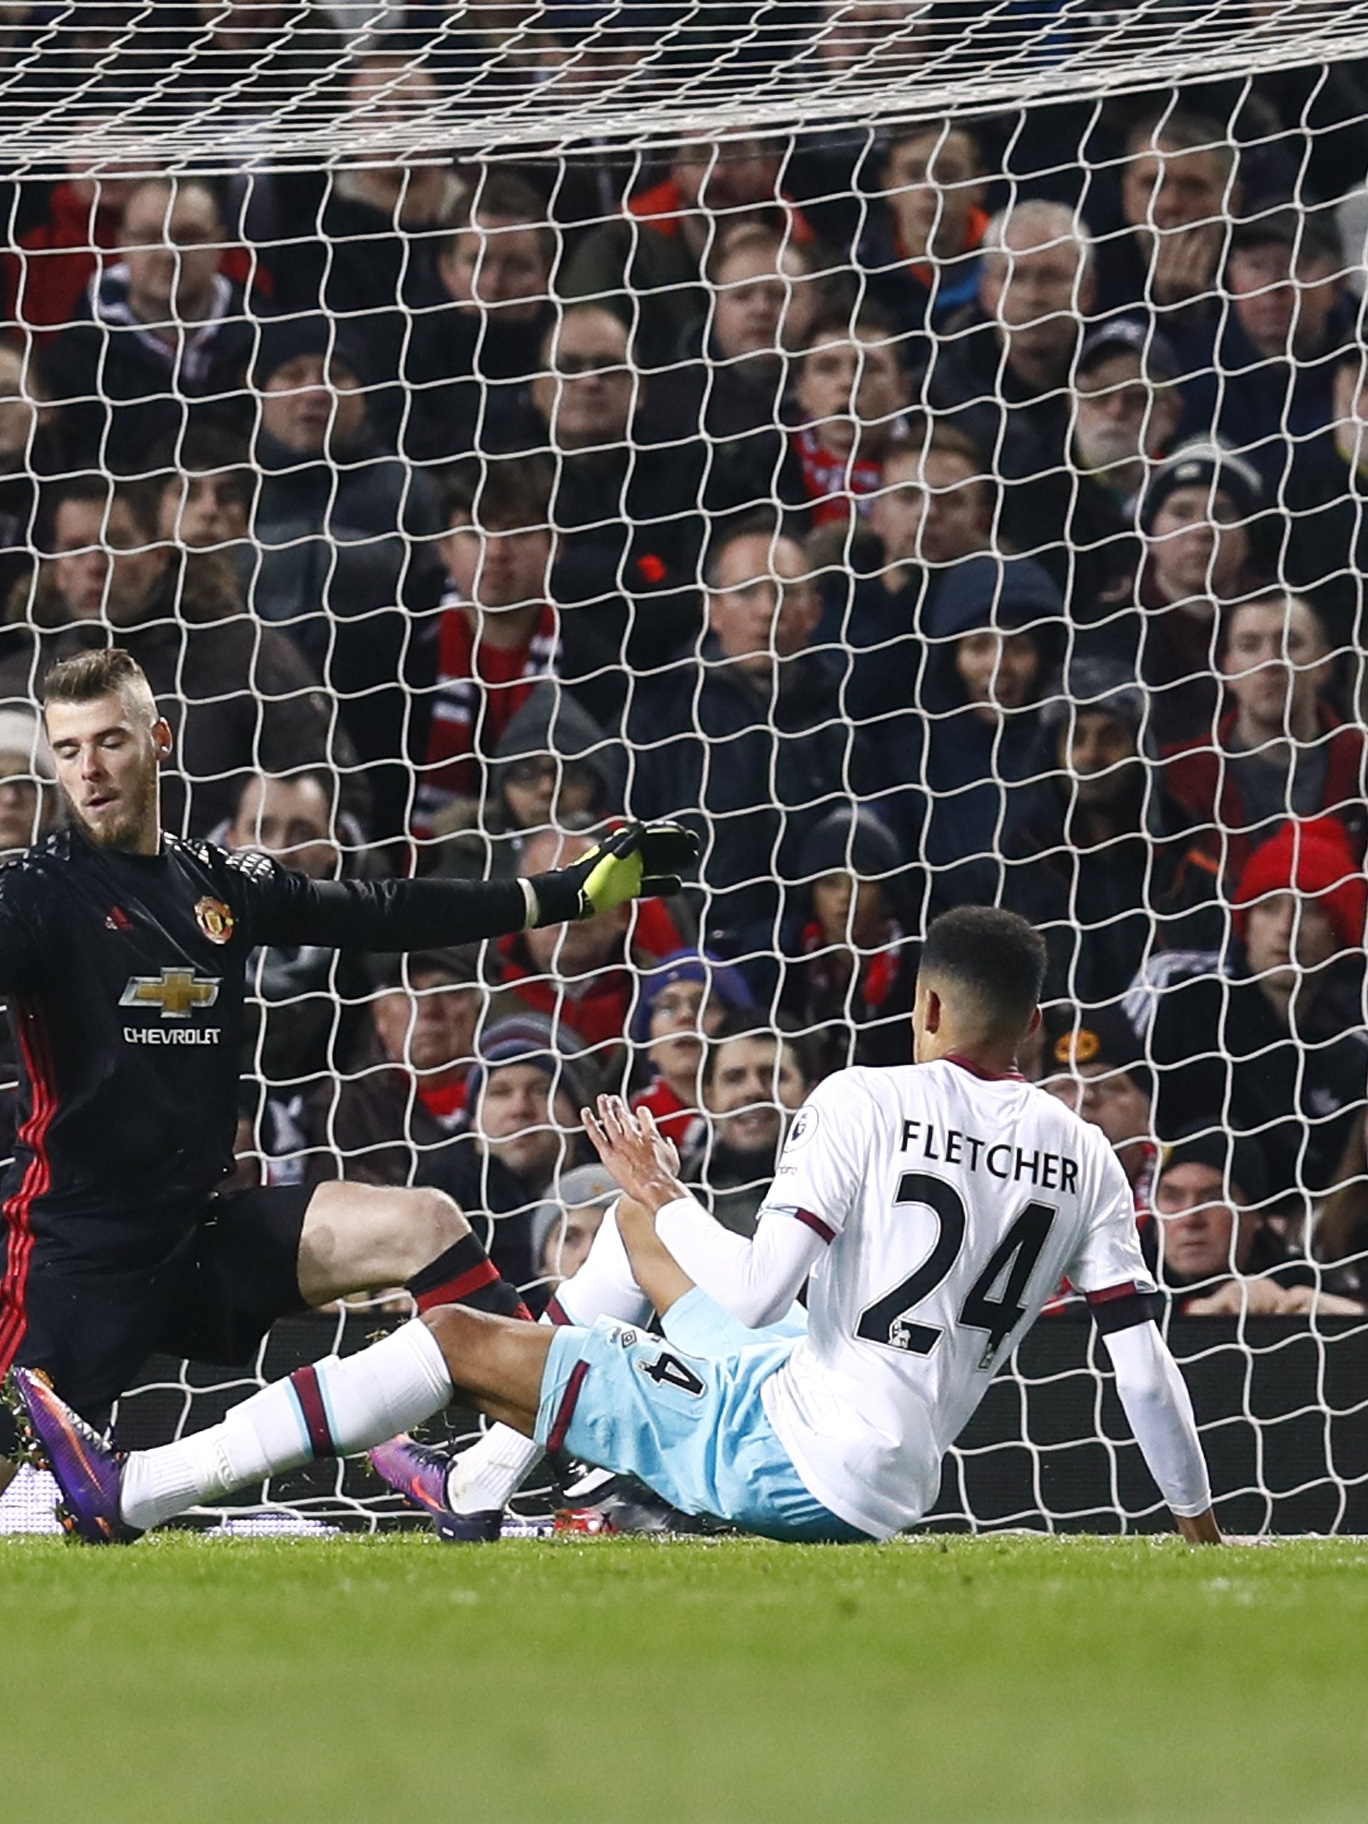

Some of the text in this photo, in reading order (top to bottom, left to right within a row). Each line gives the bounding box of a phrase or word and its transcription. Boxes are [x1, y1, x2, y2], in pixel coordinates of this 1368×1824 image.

[123, 1027, 222, 1045] CHEVROLET
[899, 1118, 1080, 1196] FLETCHER
[854, 1169, 1060, 1371] 24
